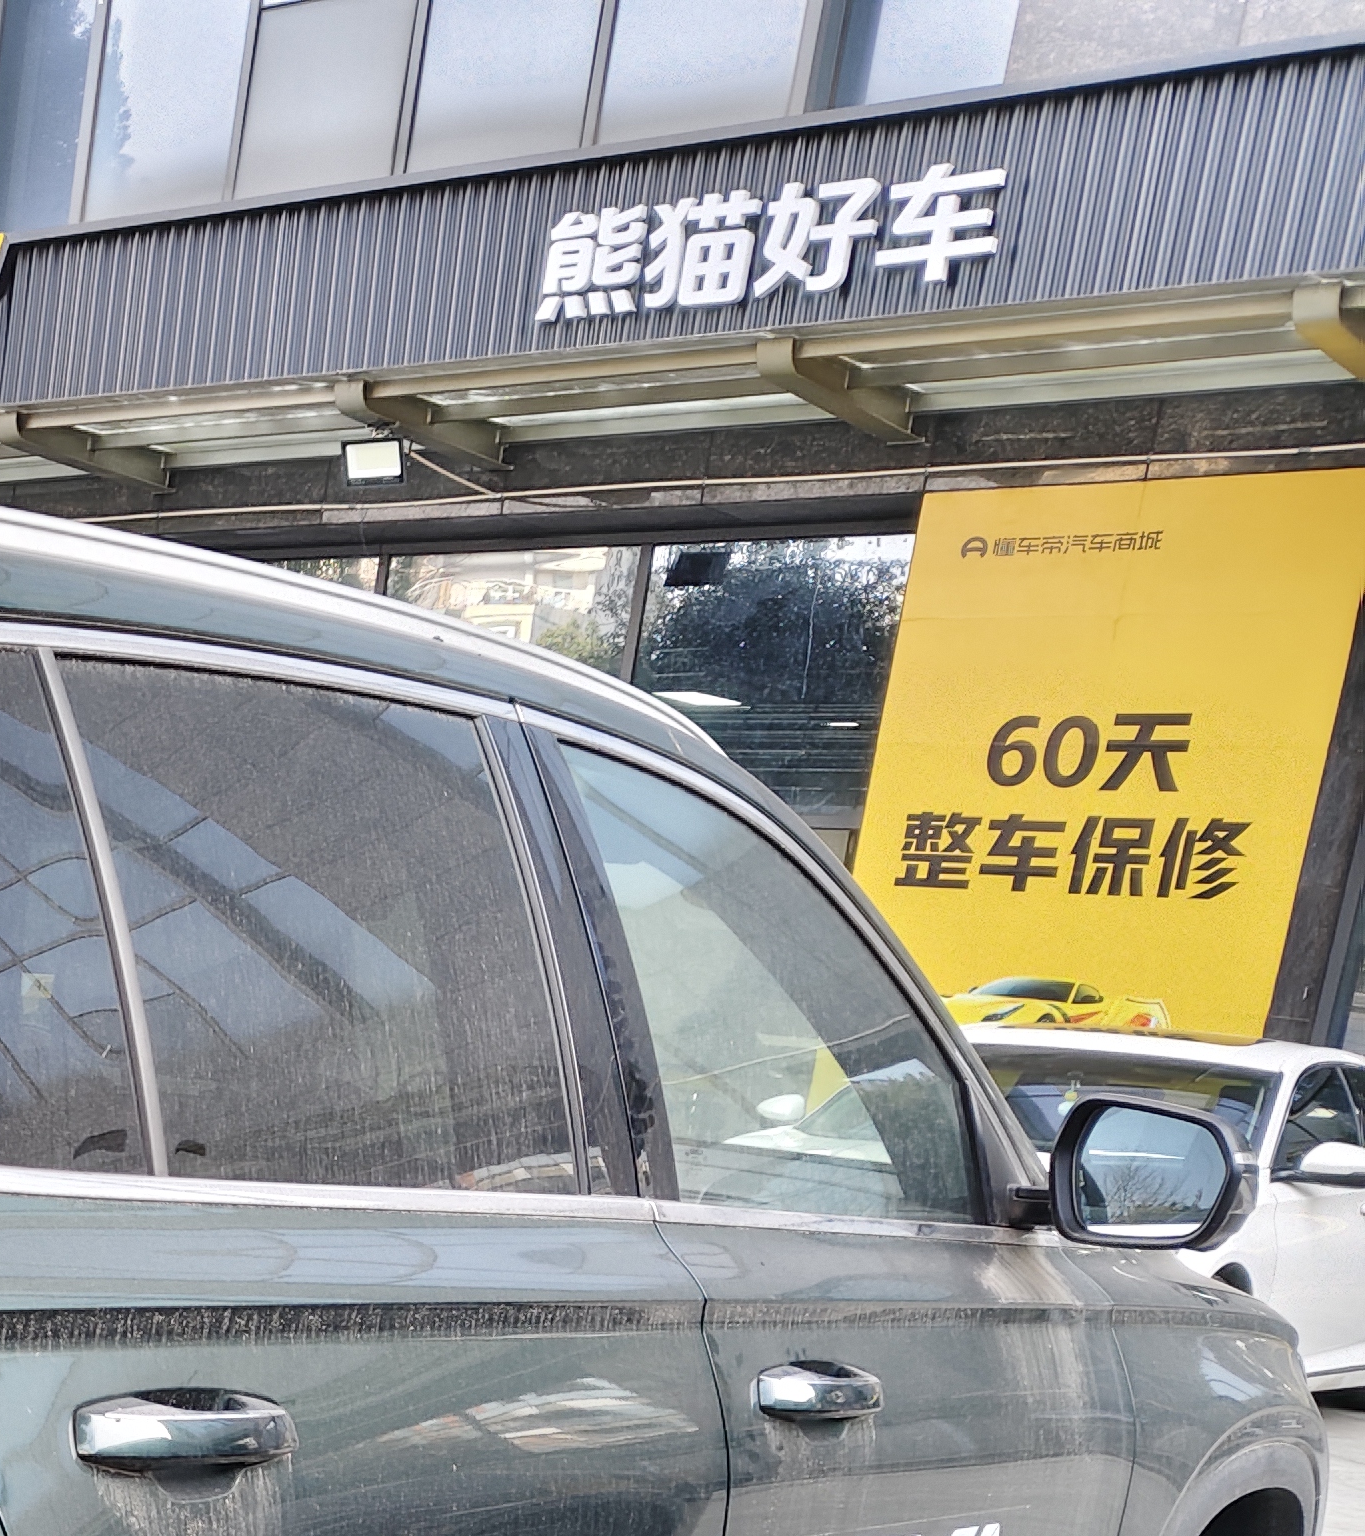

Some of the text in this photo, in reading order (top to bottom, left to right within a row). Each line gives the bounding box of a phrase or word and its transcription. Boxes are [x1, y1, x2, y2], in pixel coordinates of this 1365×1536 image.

[533, 161, 1007, 323] 熊猫好车
[993, 529, 1164, 557] 懂车帝汽车商城
[985, 713, 1193, 792] 60天
[894, 811, 1252, 900] 整车保修
